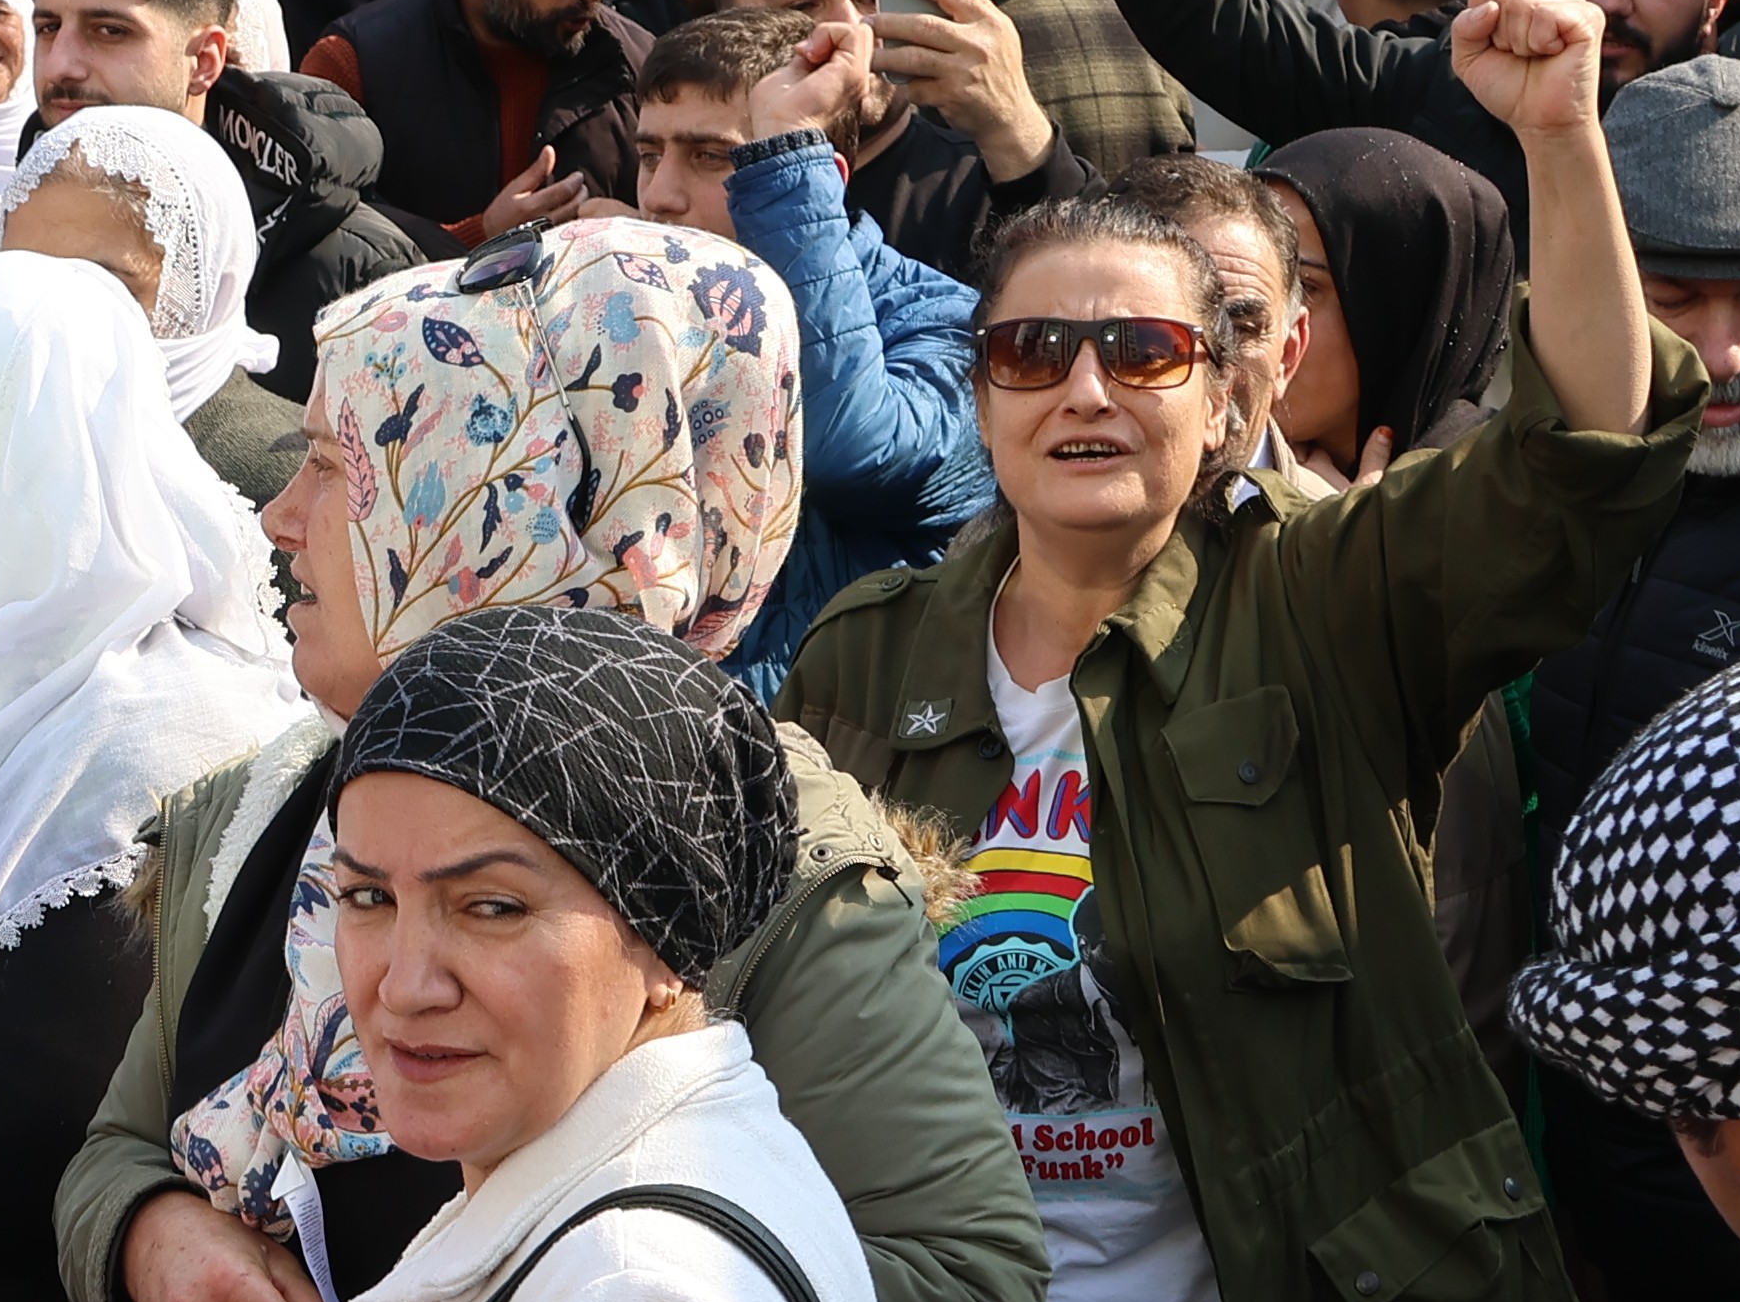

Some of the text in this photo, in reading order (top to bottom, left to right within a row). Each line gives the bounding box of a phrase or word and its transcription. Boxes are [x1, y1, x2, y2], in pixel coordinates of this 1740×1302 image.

[220, 104, 303, 186] MONCLER
[963, 963, 994, 999] KLIN
[996, 952, 1028, 972] AND
[1032, 1117, 1155, 1152] School
